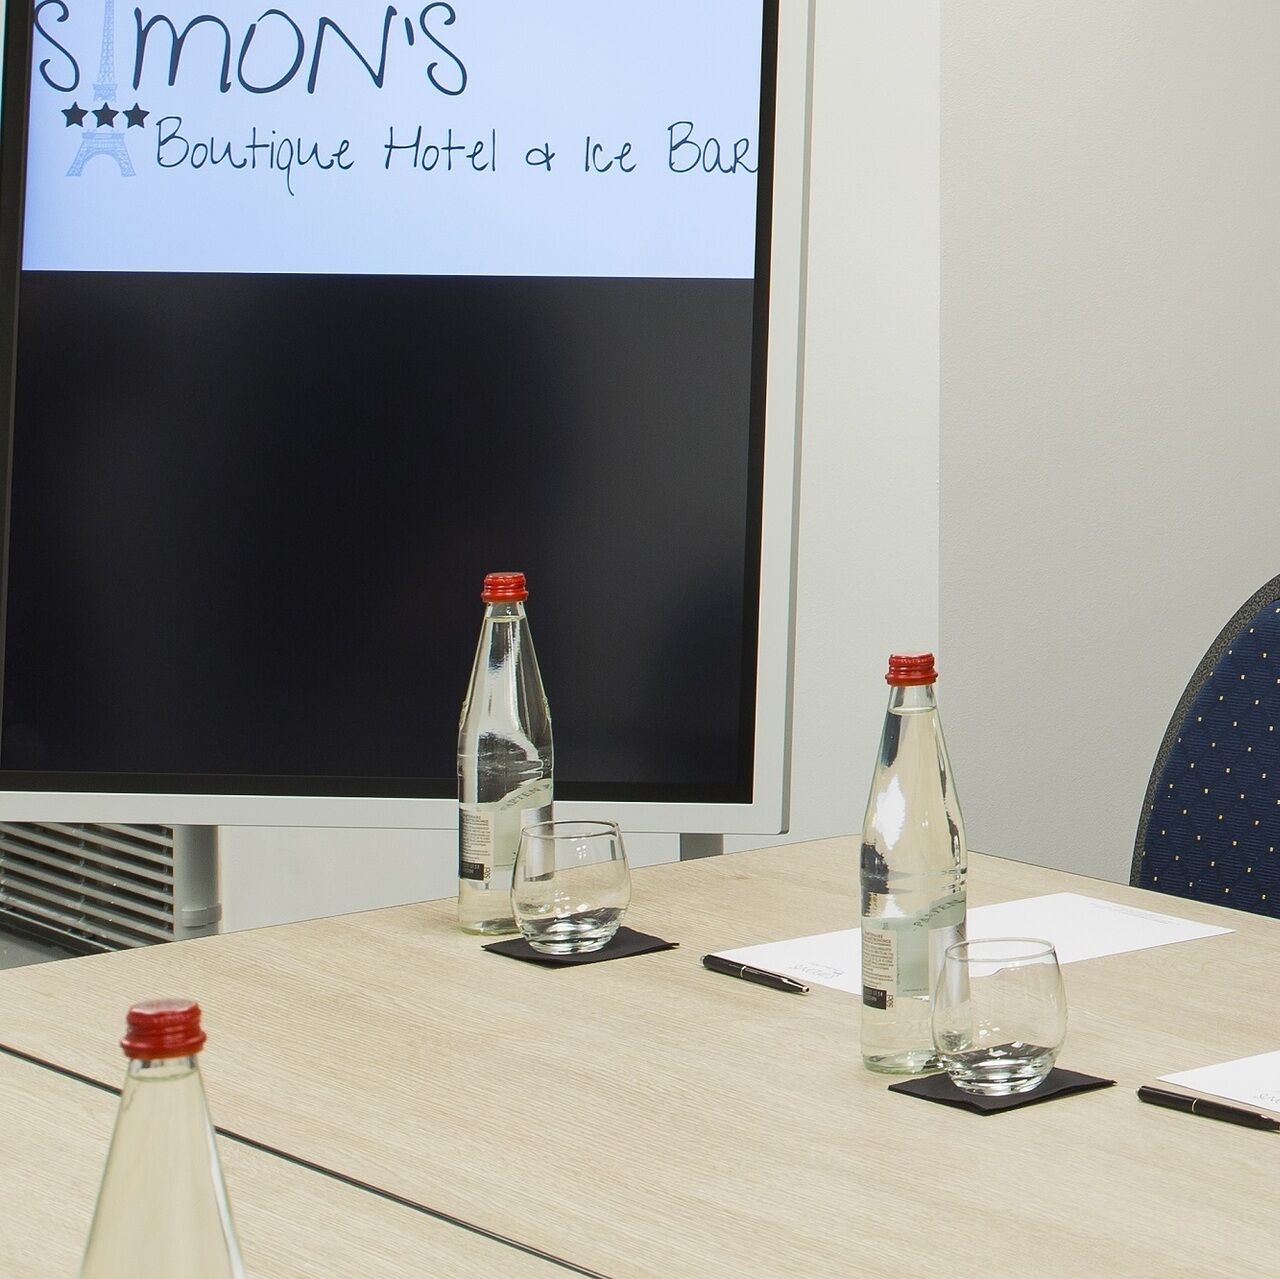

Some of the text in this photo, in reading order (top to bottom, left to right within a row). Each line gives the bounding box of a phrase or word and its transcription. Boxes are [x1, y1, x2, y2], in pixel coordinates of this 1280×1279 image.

[156, 116, 354, 196] Boutique
[384, 125, 496, 172] Hotel
[584, 136, 637, 173] Ice
